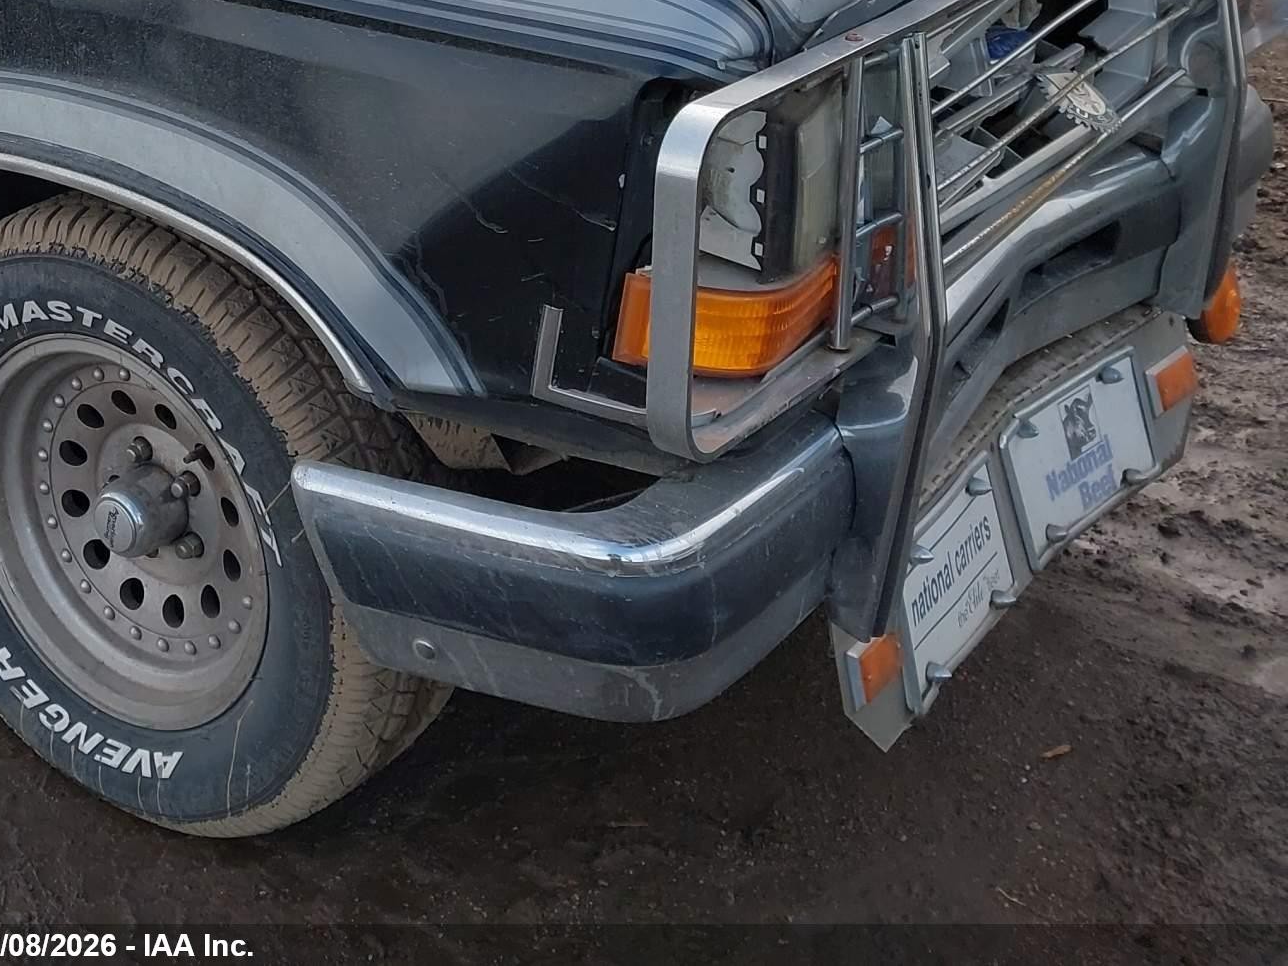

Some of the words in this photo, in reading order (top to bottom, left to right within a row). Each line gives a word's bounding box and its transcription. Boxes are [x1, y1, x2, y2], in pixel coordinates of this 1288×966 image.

[1046, 434, 1114, 502] National
[1078, 461, 1117, 512] Beef
[911, 551, 954, 627] national
[954, 515, 991, 576] carriers
